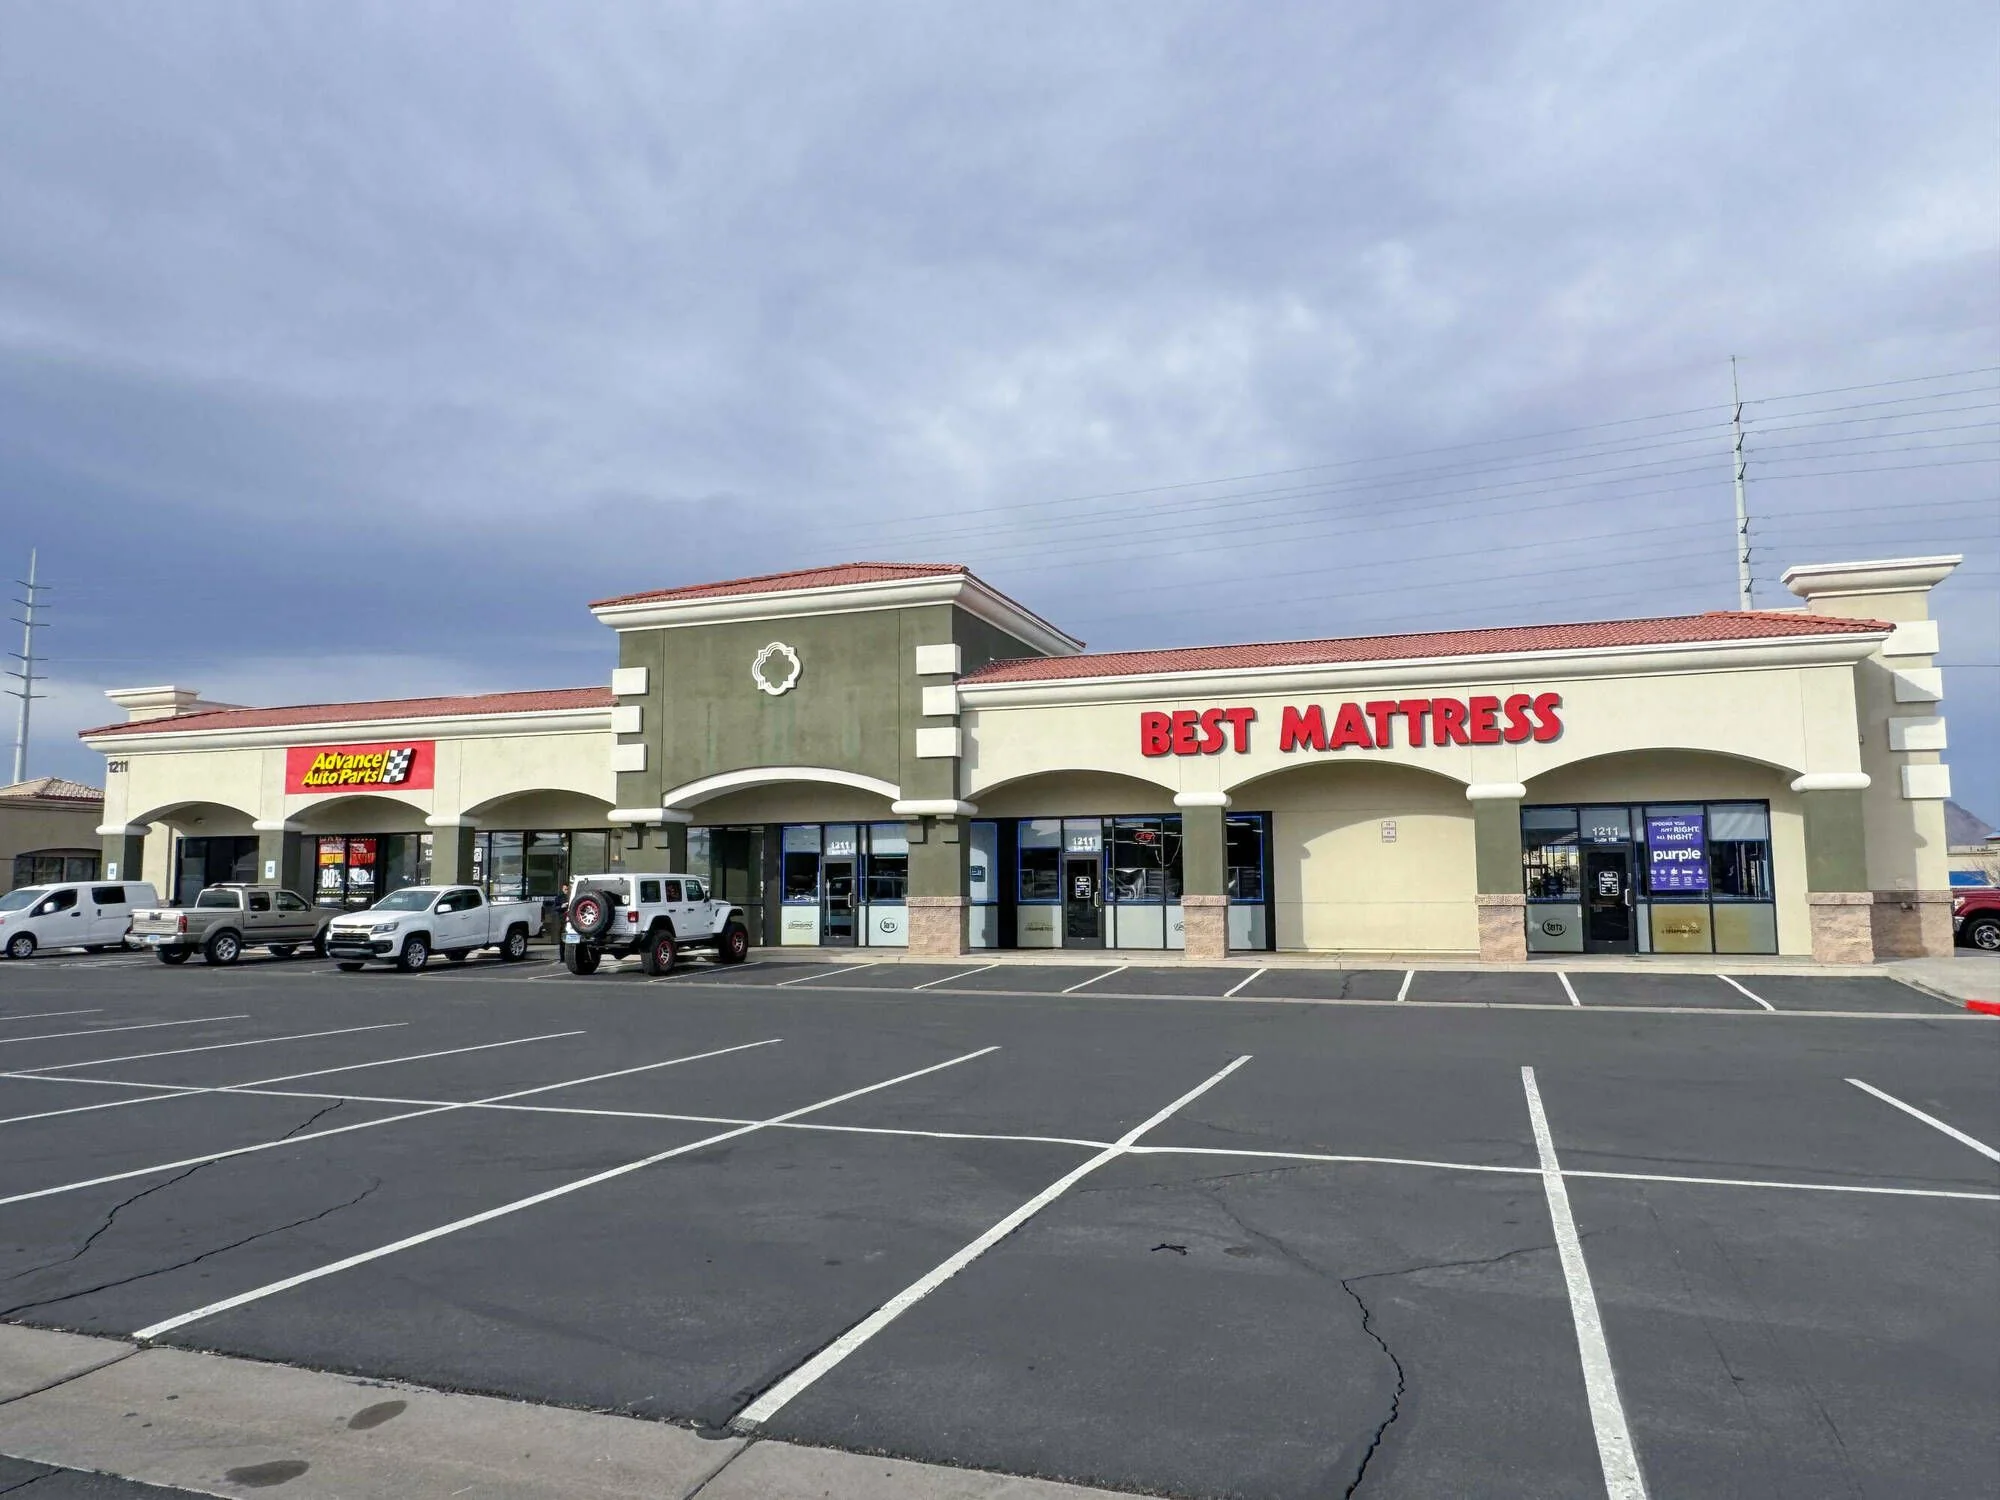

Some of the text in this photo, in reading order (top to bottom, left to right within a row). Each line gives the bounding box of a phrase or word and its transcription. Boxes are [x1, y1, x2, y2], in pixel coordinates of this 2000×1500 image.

[1141, 692, 1562, 757] BEST MATTRESS
[108, 760, 128, 773] 1211
[311, 752, 382, 769] Advance
[302, 769, 378, 785] Auto Parts
[1592, 826, 1618, 836] 1211
[1653, 847, 1701, 862] purple
